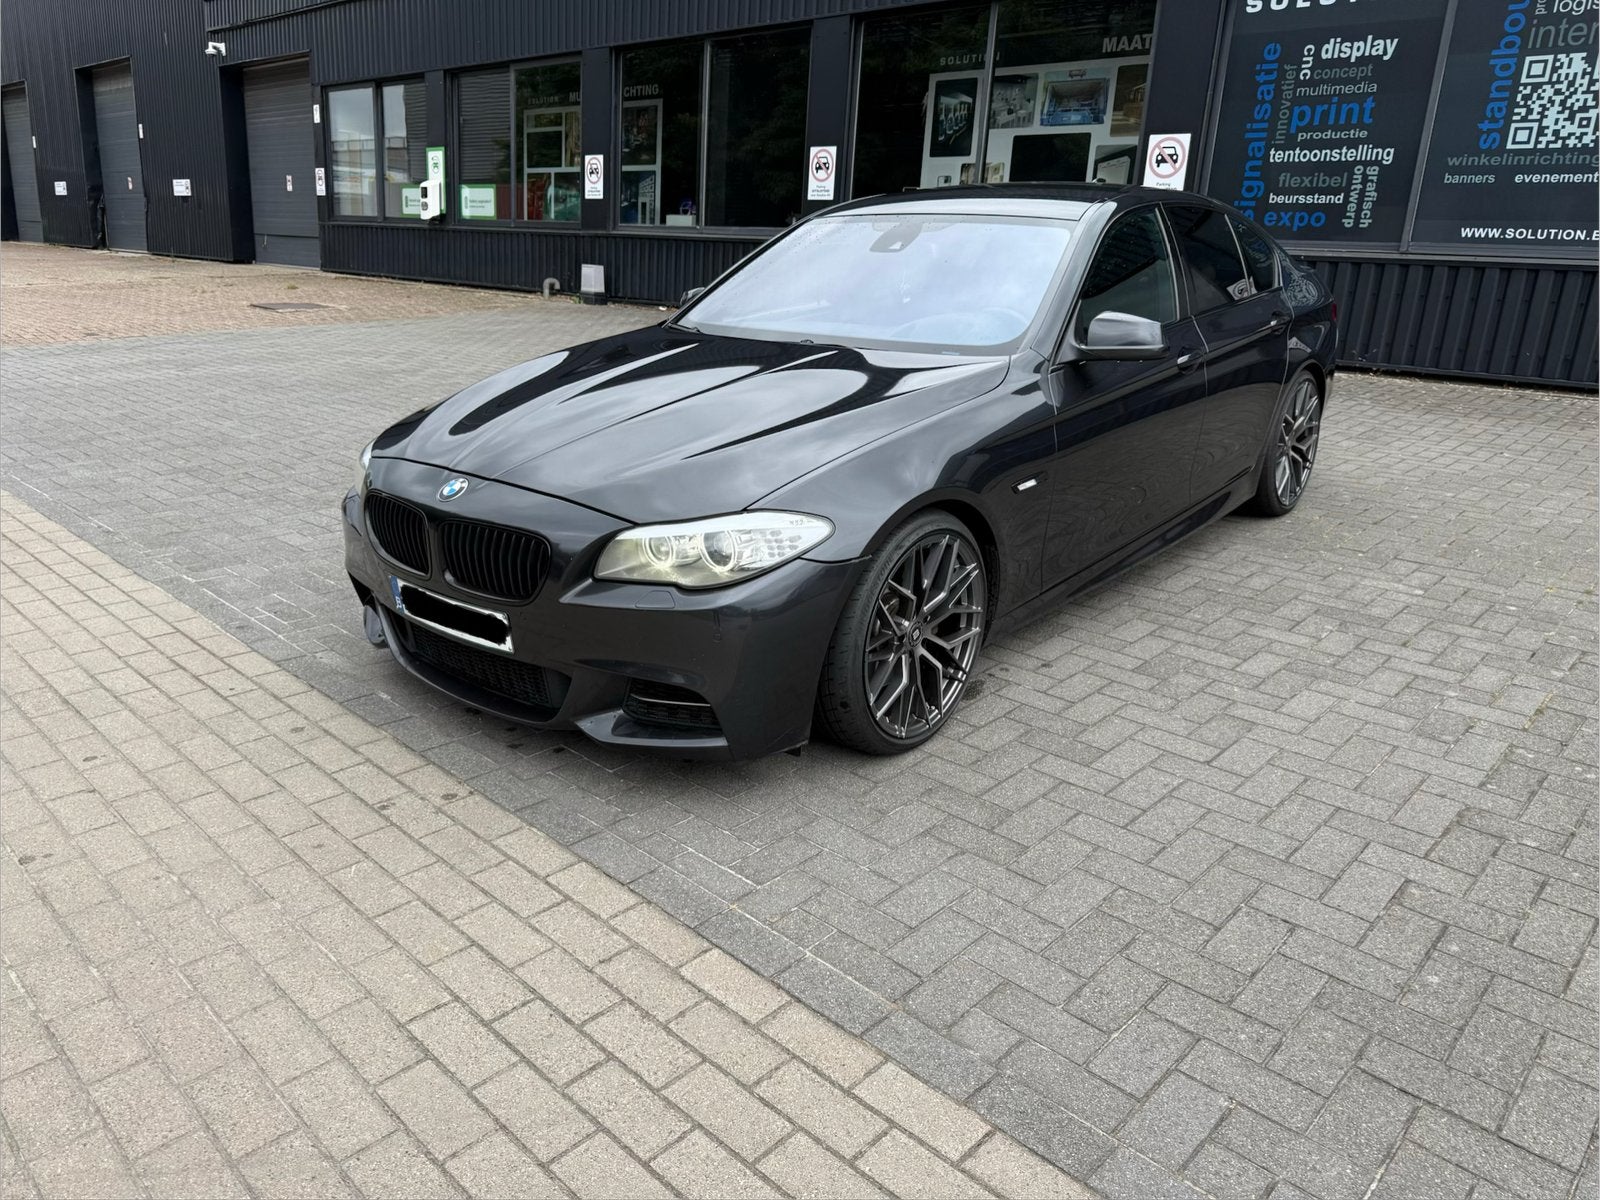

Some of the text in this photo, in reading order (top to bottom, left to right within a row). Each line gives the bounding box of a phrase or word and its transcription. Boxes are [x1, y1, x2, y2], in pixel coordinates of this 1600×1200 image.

[1321, 35, 1399, 62] display
[939, 51, 1000, 66] SOLUTI
[1300, 44, 1315, 80] cnc
[1313, 64, 1373, 80] concept
[1296, 82, 1378, 97] multimedia
[1272, 64, 1297, 144] innovatief
[1290, 96, 1376, 134] print
[1297, 129, 1368, 142] productie
[1269, 145, 1395, 165] tentoonstelling
[1447, 152, 1599, 167] winkelinrichting
[1278, 172, 1348, 188] flexibel
[1444, 173, 1496, 184] banners
[1514, 171, 1599, 184] evenement
[1269, 193, 1344, 204] beursstand
[1342, 165, 1364, 228] ontwerp
[1359, 166, 1380, 228] grafisch
[1263, 209, 1326, 232] expo
